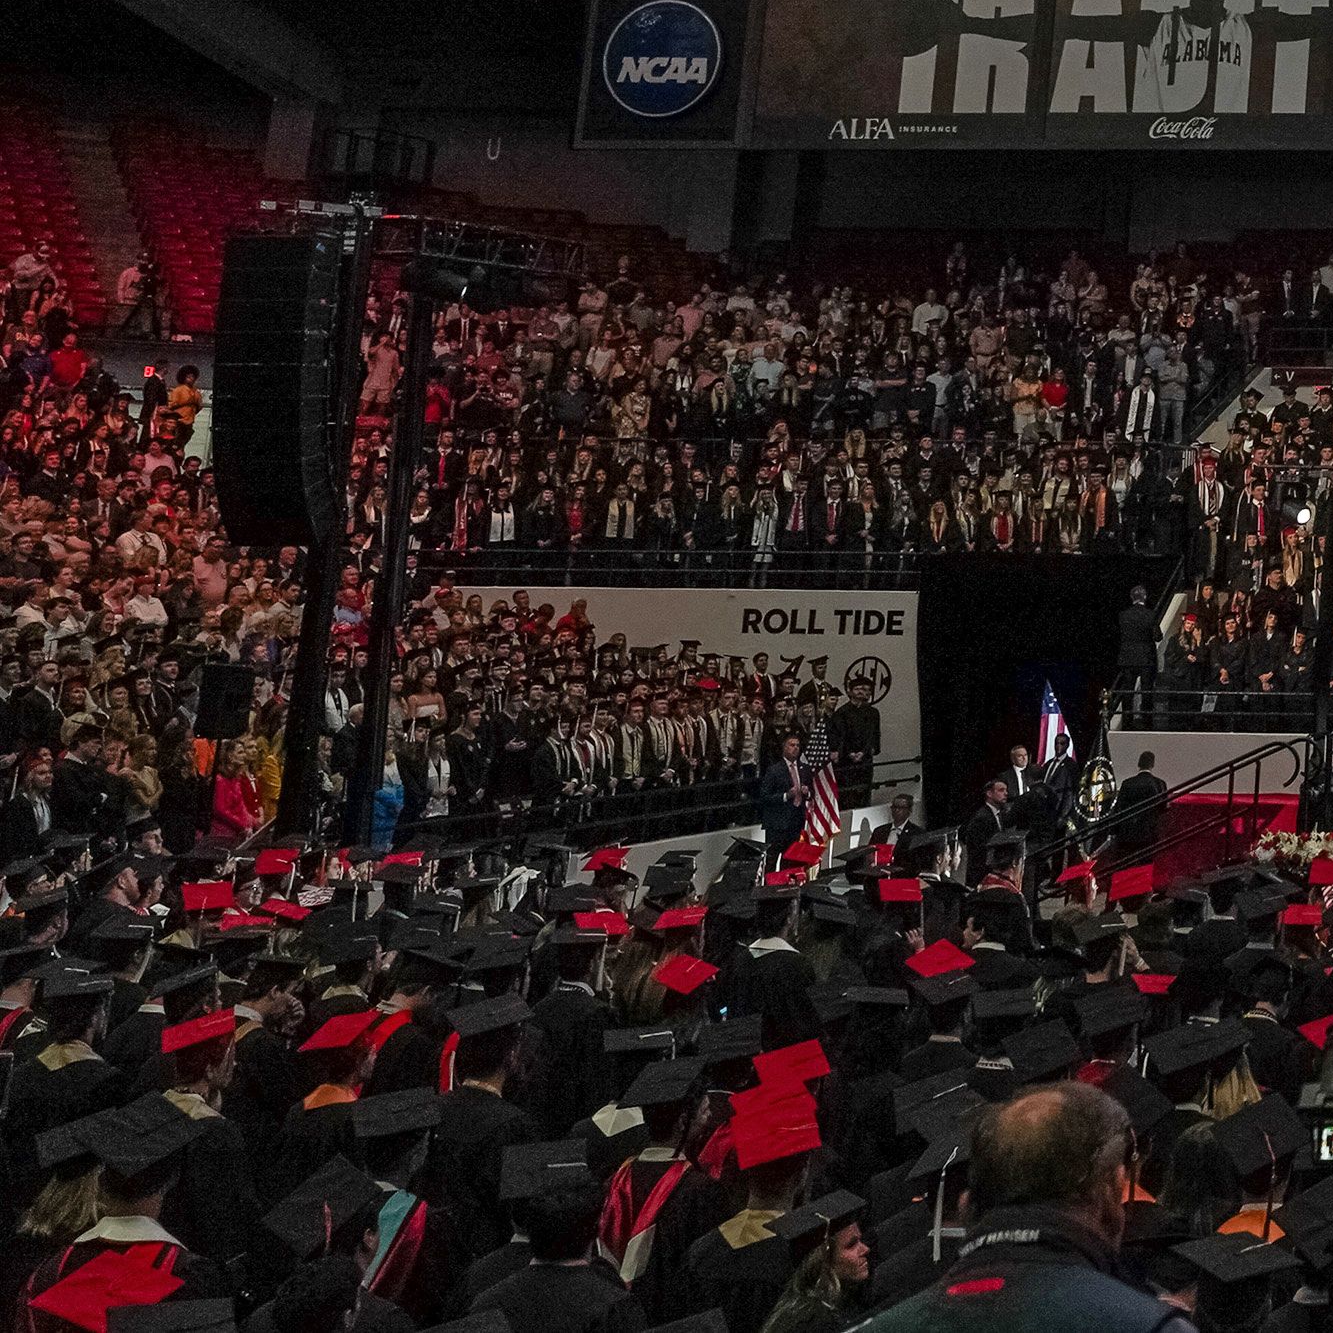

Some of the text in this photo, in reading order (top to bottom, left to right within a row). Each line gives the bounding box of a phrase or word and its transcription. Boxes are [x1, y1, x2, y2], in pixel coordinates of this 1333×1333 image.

[615, 55, 708, 84] NCAA
[828, 118, 958, 140] ALFA INSURANCE
[1149, 116, 1218, 139] Coca-Cola
[741, 608, 905, 636] ROLL TIDE
